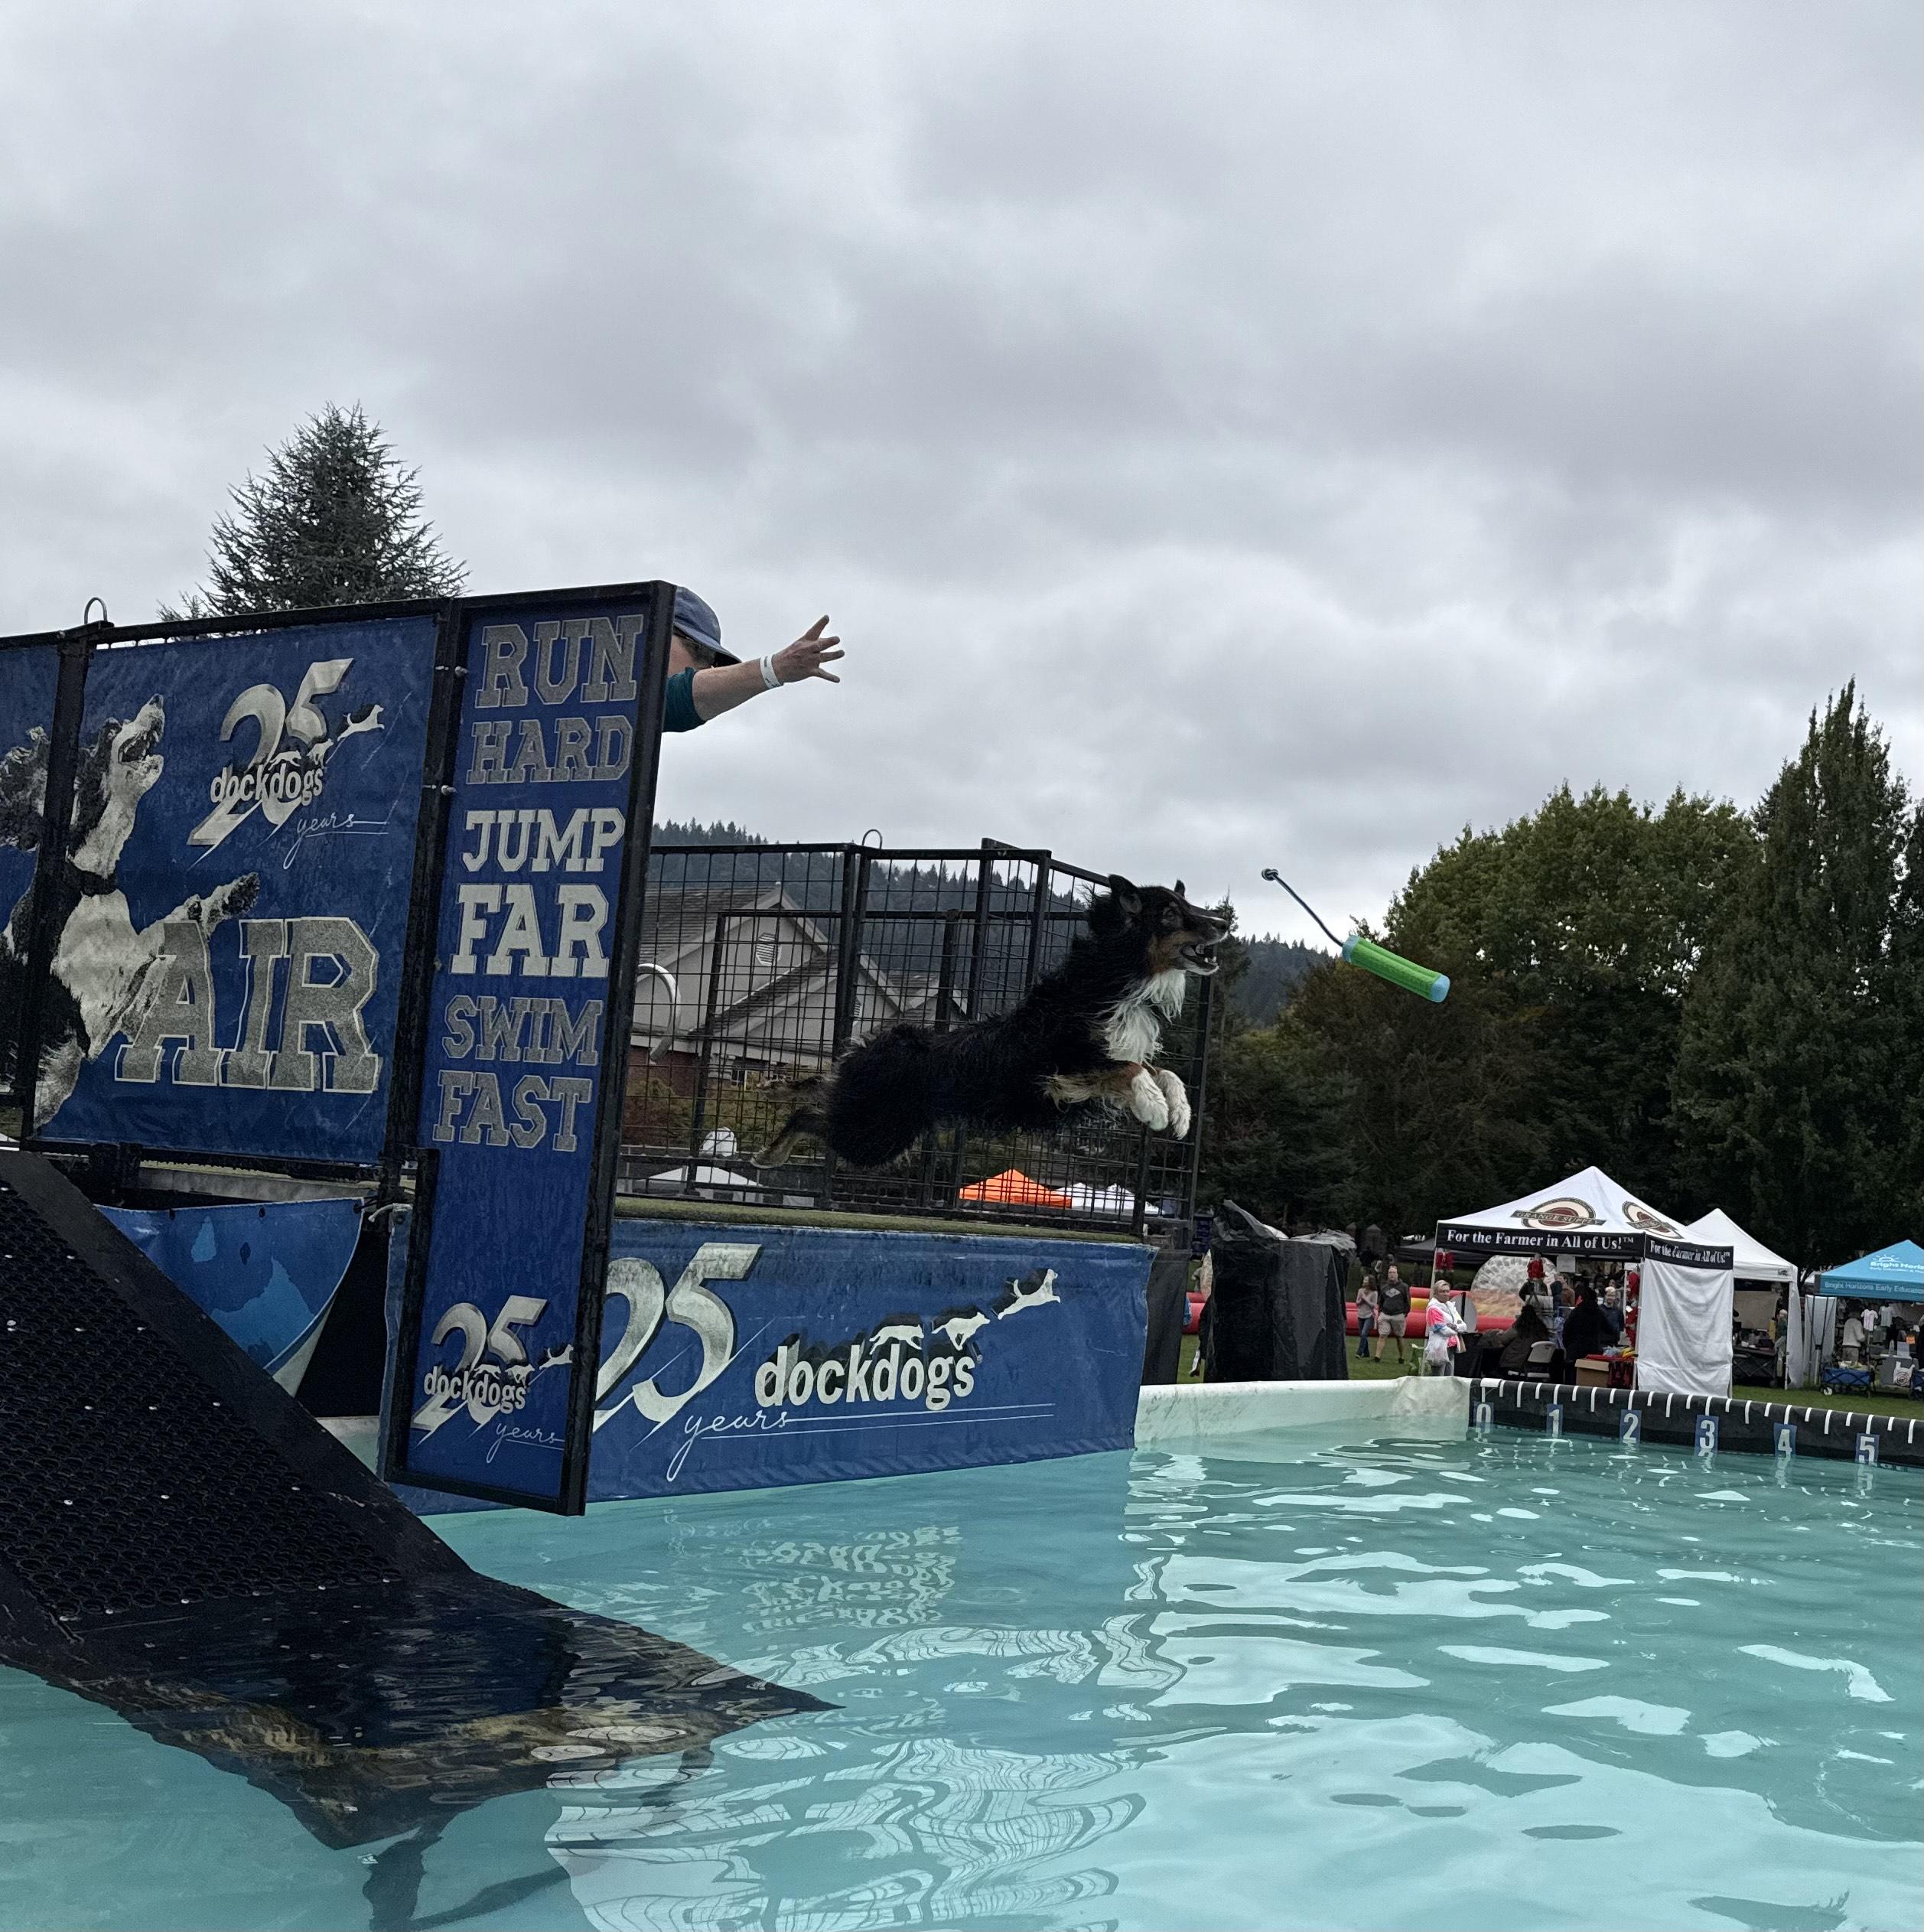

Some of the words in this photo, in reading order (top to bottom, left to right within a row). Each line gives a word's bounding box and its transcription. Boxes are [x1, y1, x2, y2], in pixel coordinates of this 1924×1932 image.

[475, 614, 643, 708] RUN
[187, 658, 355, 847] 25
[466, 715, 633, 784] HARD
[210, 763, 324, 806] dockdogs
[283, 812, 356, 870] years
[462, 808, 626, 872] JUMP
[449, 884, 610, 977] FAR
[115, 917, 383, 1094] AIR
[441, 995, 604, 1066] SWIM
[432, 1070, 593, 1152] FAST
[1447, 1229, 1470, 1243] For
[1473, 1230, 1492, 1243] the
[1496, 1232, 1544, 1246] Farmer
[1546, 1233, 1558, 1247] in
[1561, 1235, 1581, 1248] All
[1584, 1236, 1597, 1249] of
[1516, 1211, 1559, 1221] GRANGE
[1650, 1240, 1661, 1254] For
[1662, 1244, 1671, 1257] the
[1672, 1246, 1694, 1261] Farmer
[1694, 1249, 1701, 1262] in
[1701, 1250, 1711, 1262] All
[1711, 1250, 1717, 1262] of
[1845, 1282, 1874, 1291] Horizons
[1876, 1284, 1893, 1293] Early
[410, 1295, 548, 1432] 25
[592, 1242, 762, 1434] 25
[424, 1366, 526, 1414] dockdogs
[755, 1344, 976, 1410] dockdogs
[486, 1422, 557, 1464] years
[1476, 1403, 1491, 1433] 0
[1548, 1409, 1560, 1438] 1
[1623, 1413, 1639, 1443] 2
[1699, 1419, 1715, 1450] 3
[1777, 1429, 1792, 1455] 4
[666, 1410, 788, 1482] years
[1858, 1435, 1875, 1464] 5
